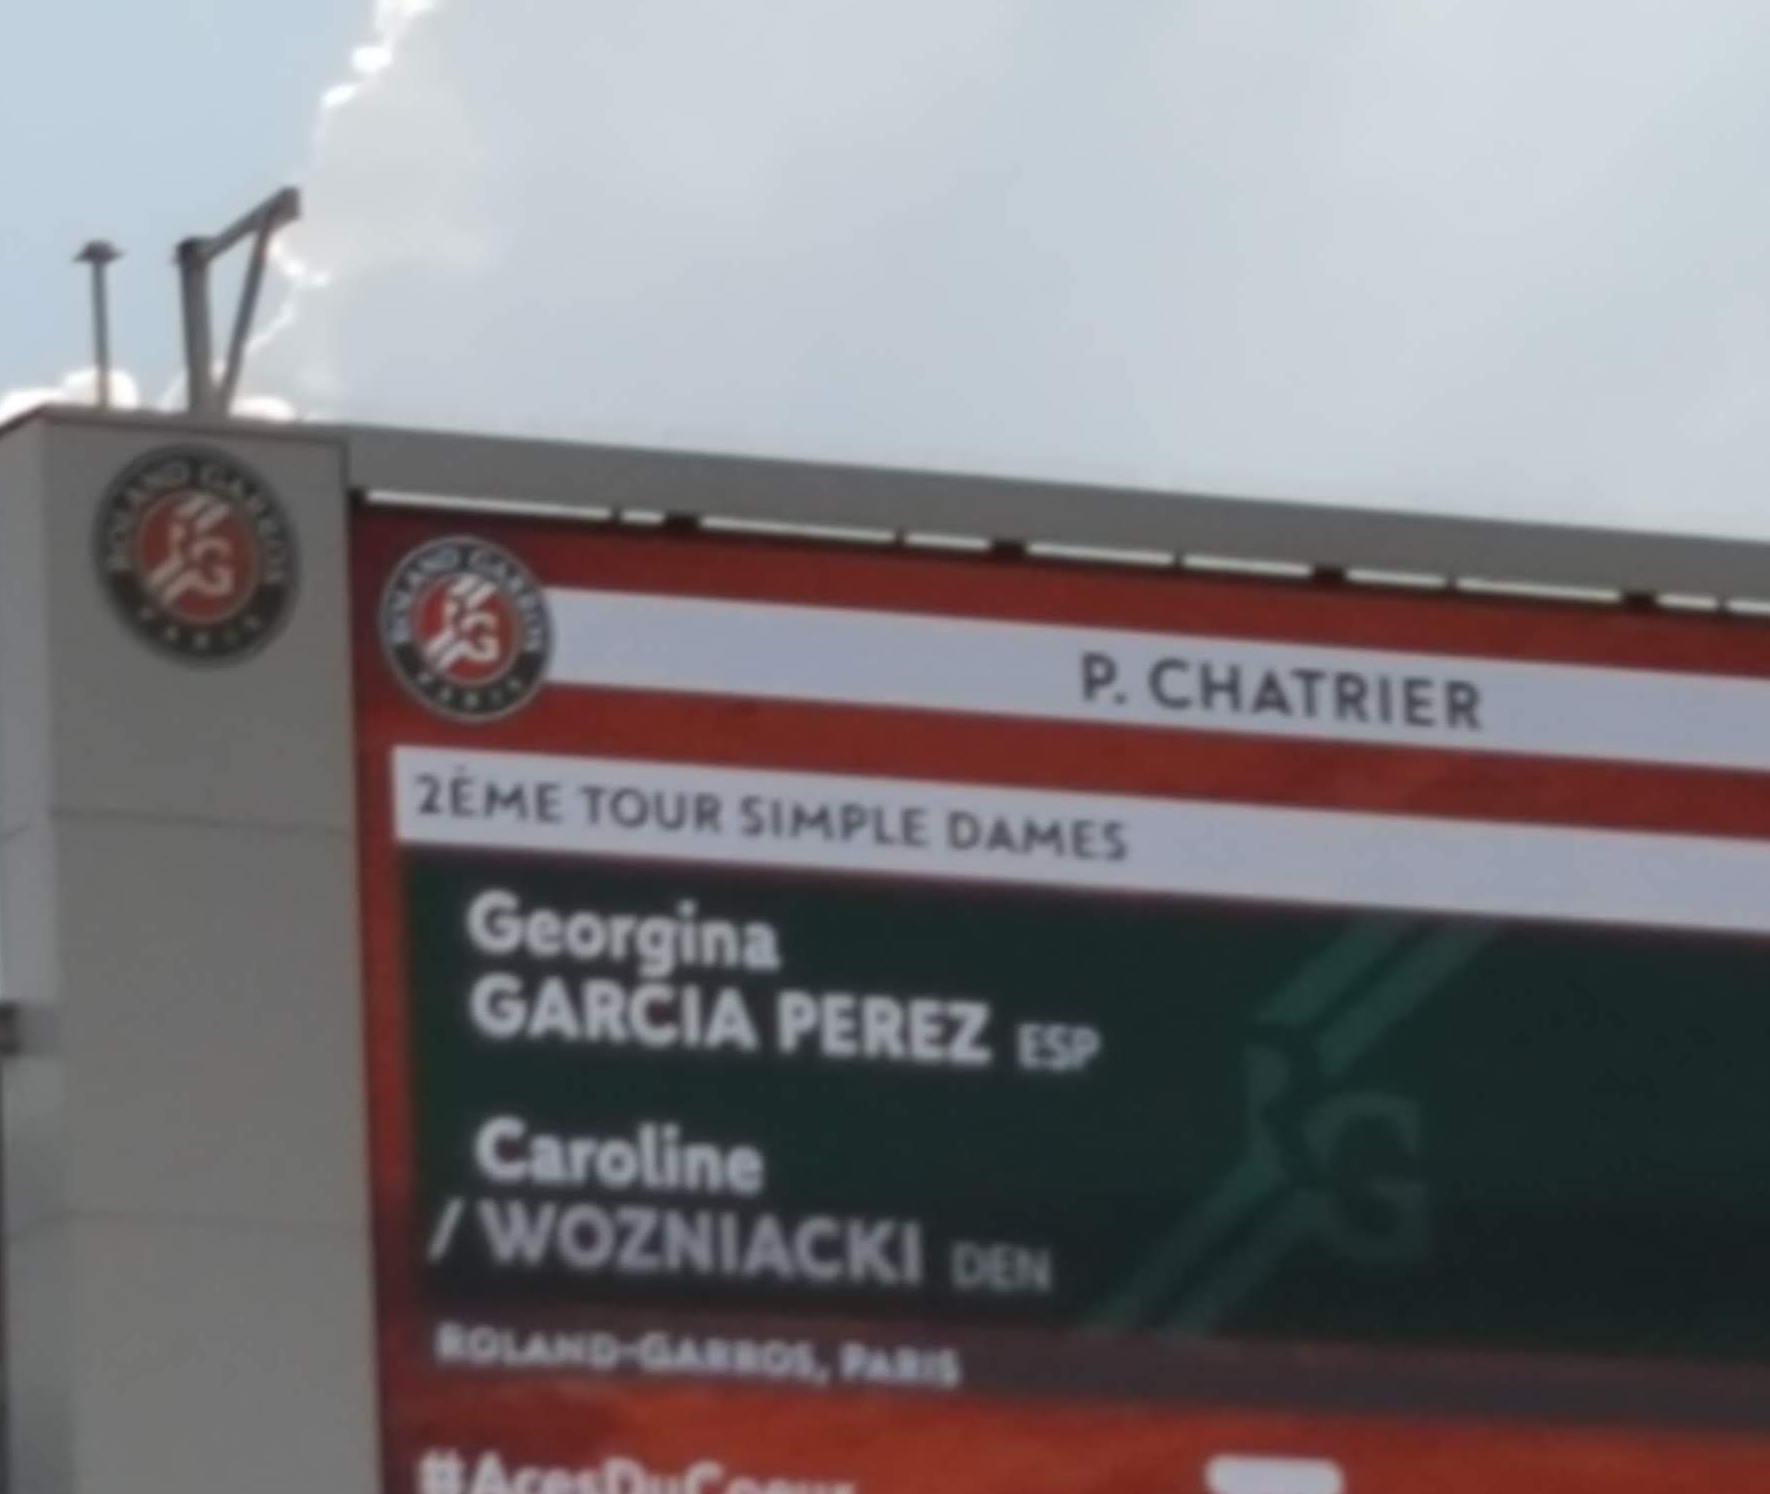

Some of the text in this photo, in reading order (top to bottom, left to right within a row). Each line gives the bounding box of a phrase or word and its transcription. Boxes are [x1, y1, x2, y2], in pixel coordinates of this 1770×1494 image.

[1079, 651, 1485, 731] P. CHATRIER
[580, 784, 723, 834] TOUR
[739, 796, 927, 849] SIMPLE
[946, 811, 1129, 862] DAMES
[465, 887, 781, 976] Georgina
[468, 974, 1102, 1073] GARCIA PEREZ ESP
[473, 1115, 765, 1195] Caroline
[477, 1198, 924, 1286] WOZNIACKI
[950, 1240, 1054, 1292] DEN
[839, 1341, 962, 1386] PARIS
